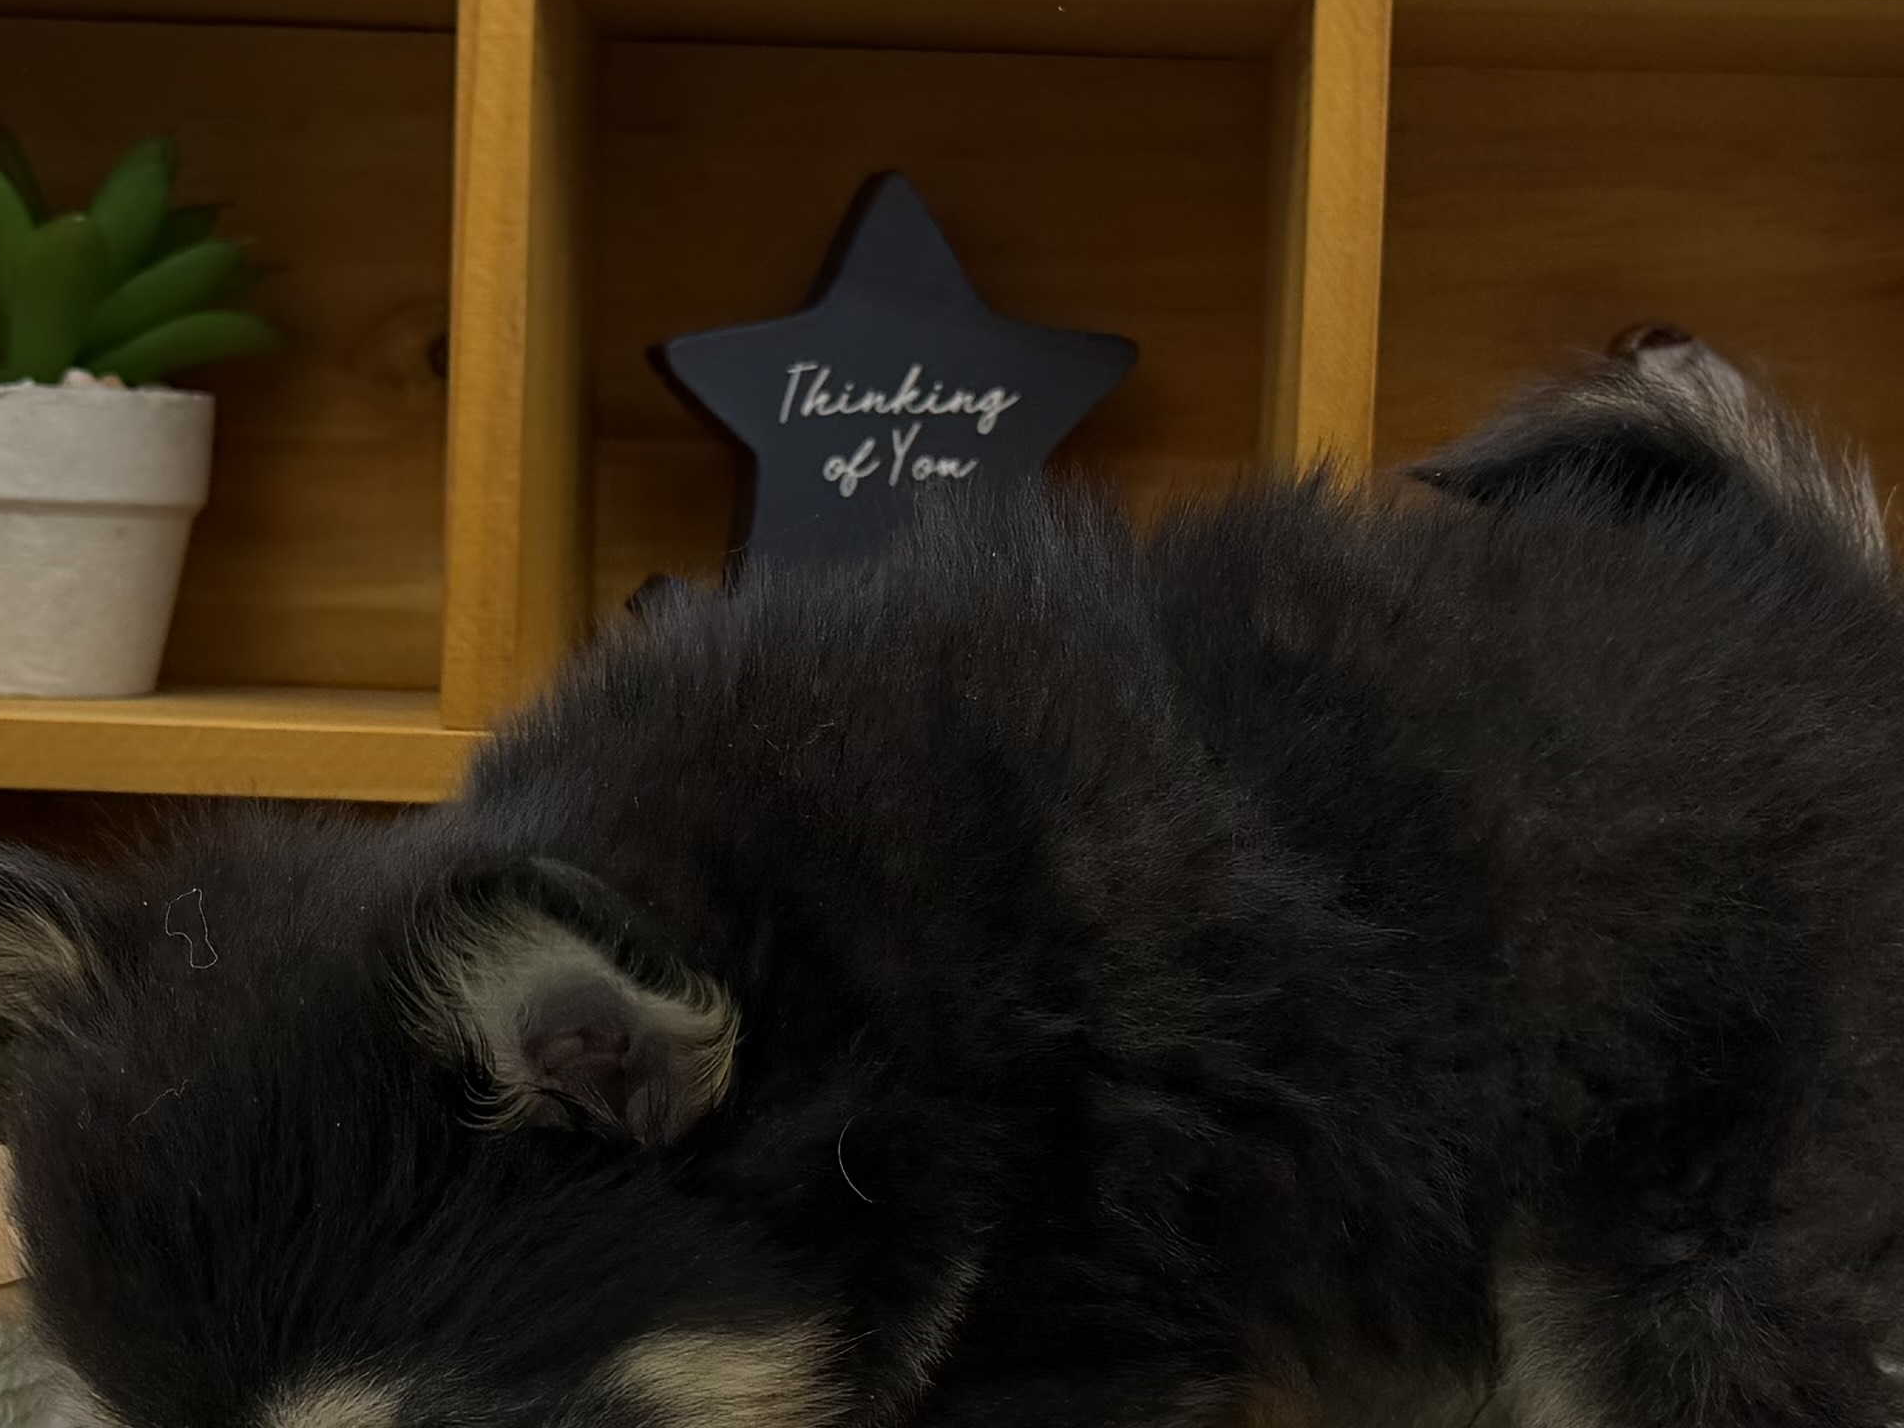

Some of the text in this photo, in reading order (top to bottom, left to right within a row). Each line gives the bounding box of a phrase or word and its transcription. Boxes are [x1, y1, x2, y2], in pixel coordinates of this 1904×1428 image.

[779, 362, 1022, 436] Thinking
[823, 422, 979, 498] of You
